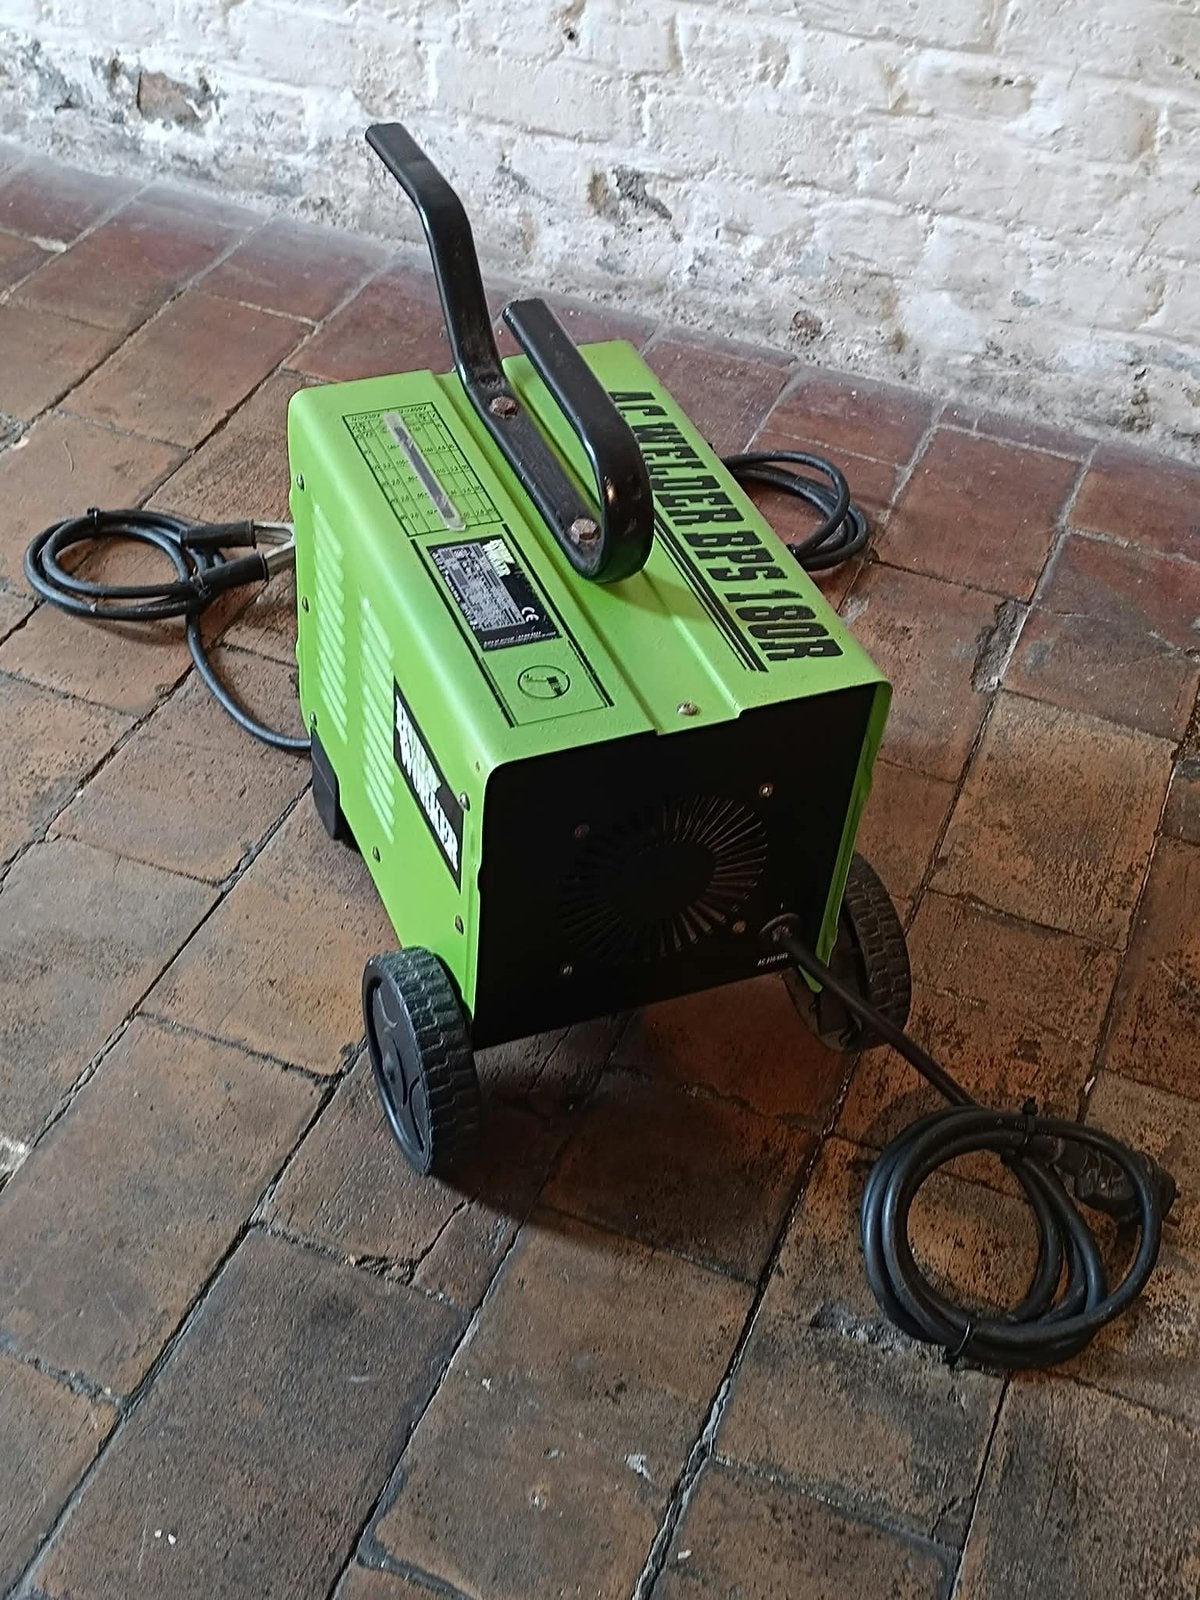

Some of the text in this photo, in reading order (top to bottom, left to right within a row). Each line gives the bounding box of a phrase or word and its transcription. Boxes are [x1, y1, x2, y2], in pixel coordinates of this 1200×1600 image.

[609, 391, 844, 662] AC WELDER BPS 180R
